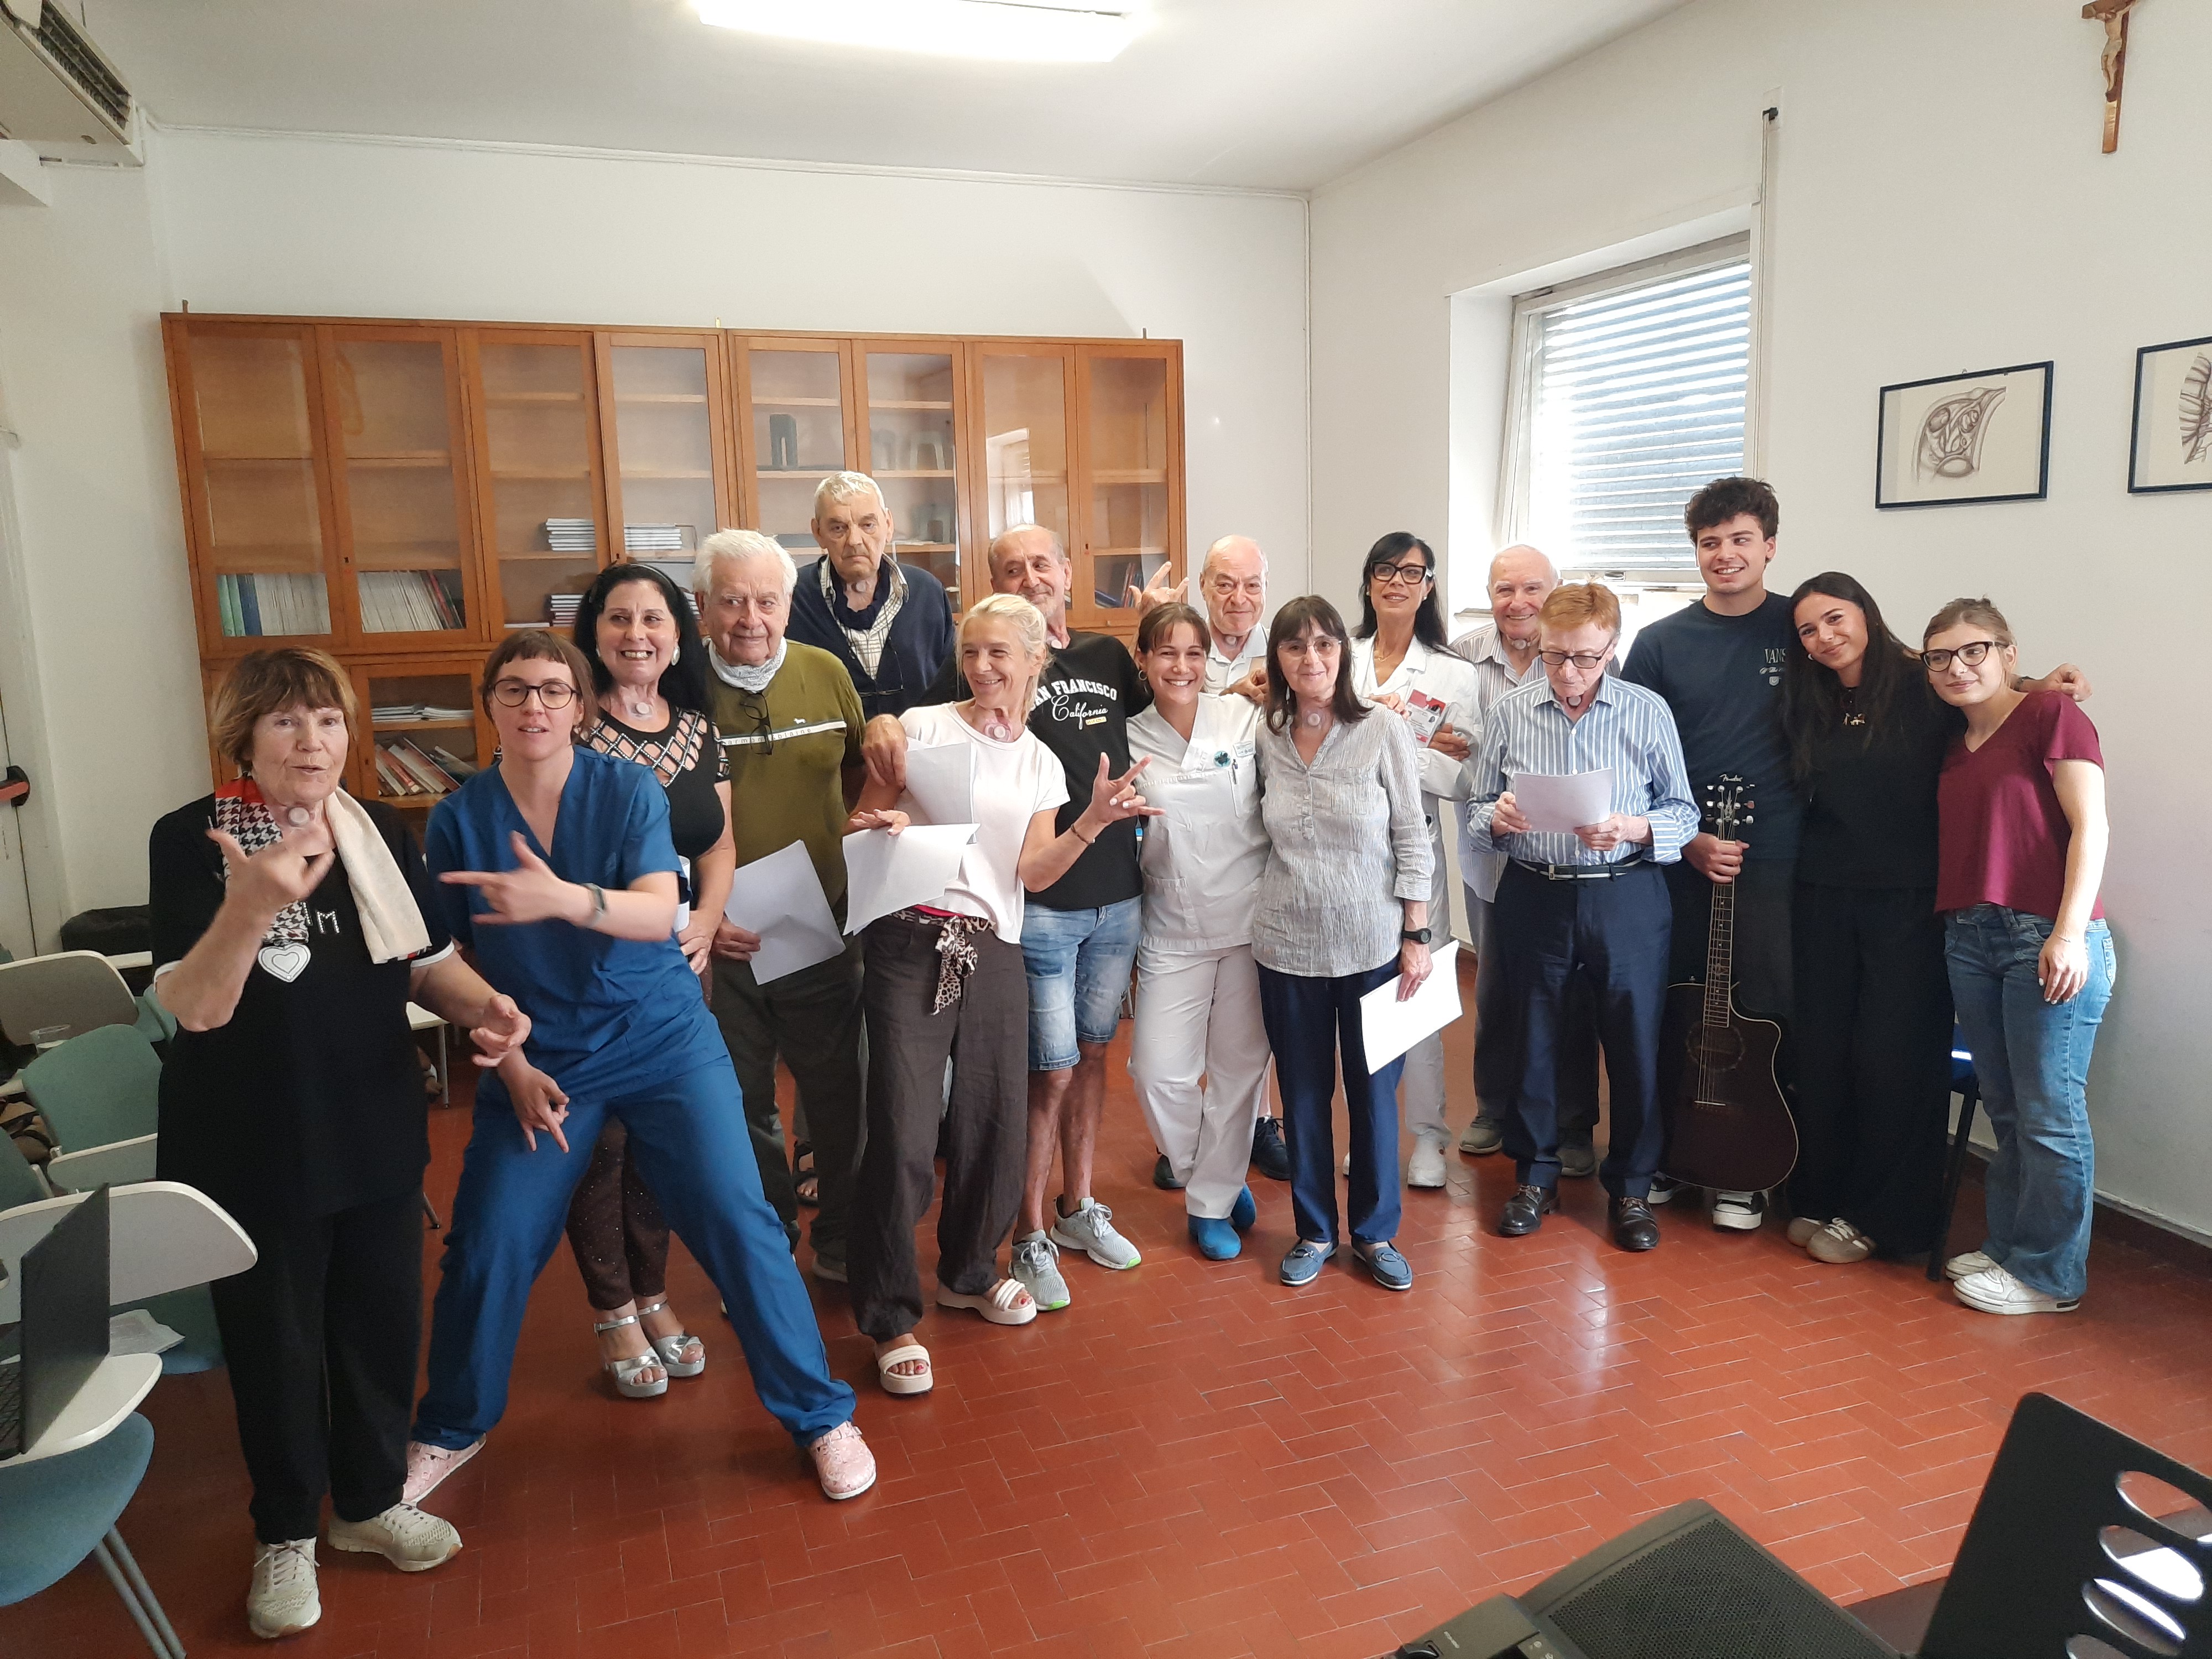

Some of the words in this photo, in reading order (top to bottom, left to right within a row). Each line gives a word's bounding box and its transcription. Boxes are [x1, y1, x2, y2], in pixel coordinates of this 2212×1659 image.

[1765, 648, 1786, 663] VANS
[1051, 679, 1117, 701] FRANCISCO
[1051, 695, 1109, 730] California
